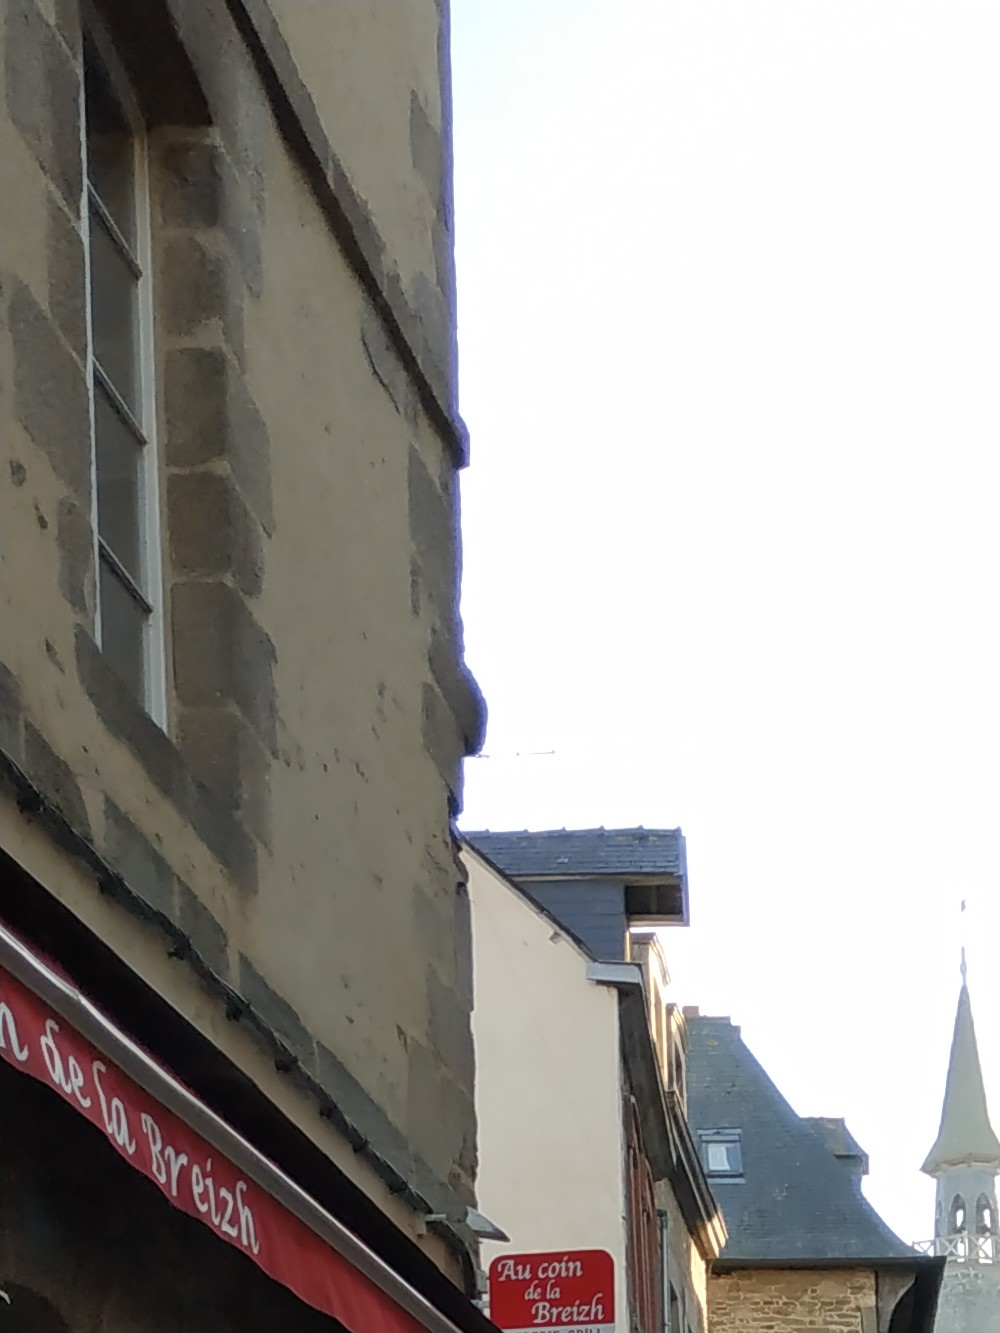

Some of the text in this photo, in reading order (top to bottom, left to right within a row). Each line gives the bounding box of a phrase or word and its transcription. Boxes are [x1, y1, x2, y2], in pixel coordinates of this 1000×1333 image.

[40, 1018, 92, 1108] de
[92, 1060, 136, 1156] la
[141, 1112, 260, 1255] Breizh
[497, 1256, 583, 1281] Au coin
[524, 1279, 561, 1300] de la
[531, 1293, 604, 1324] Breizh
